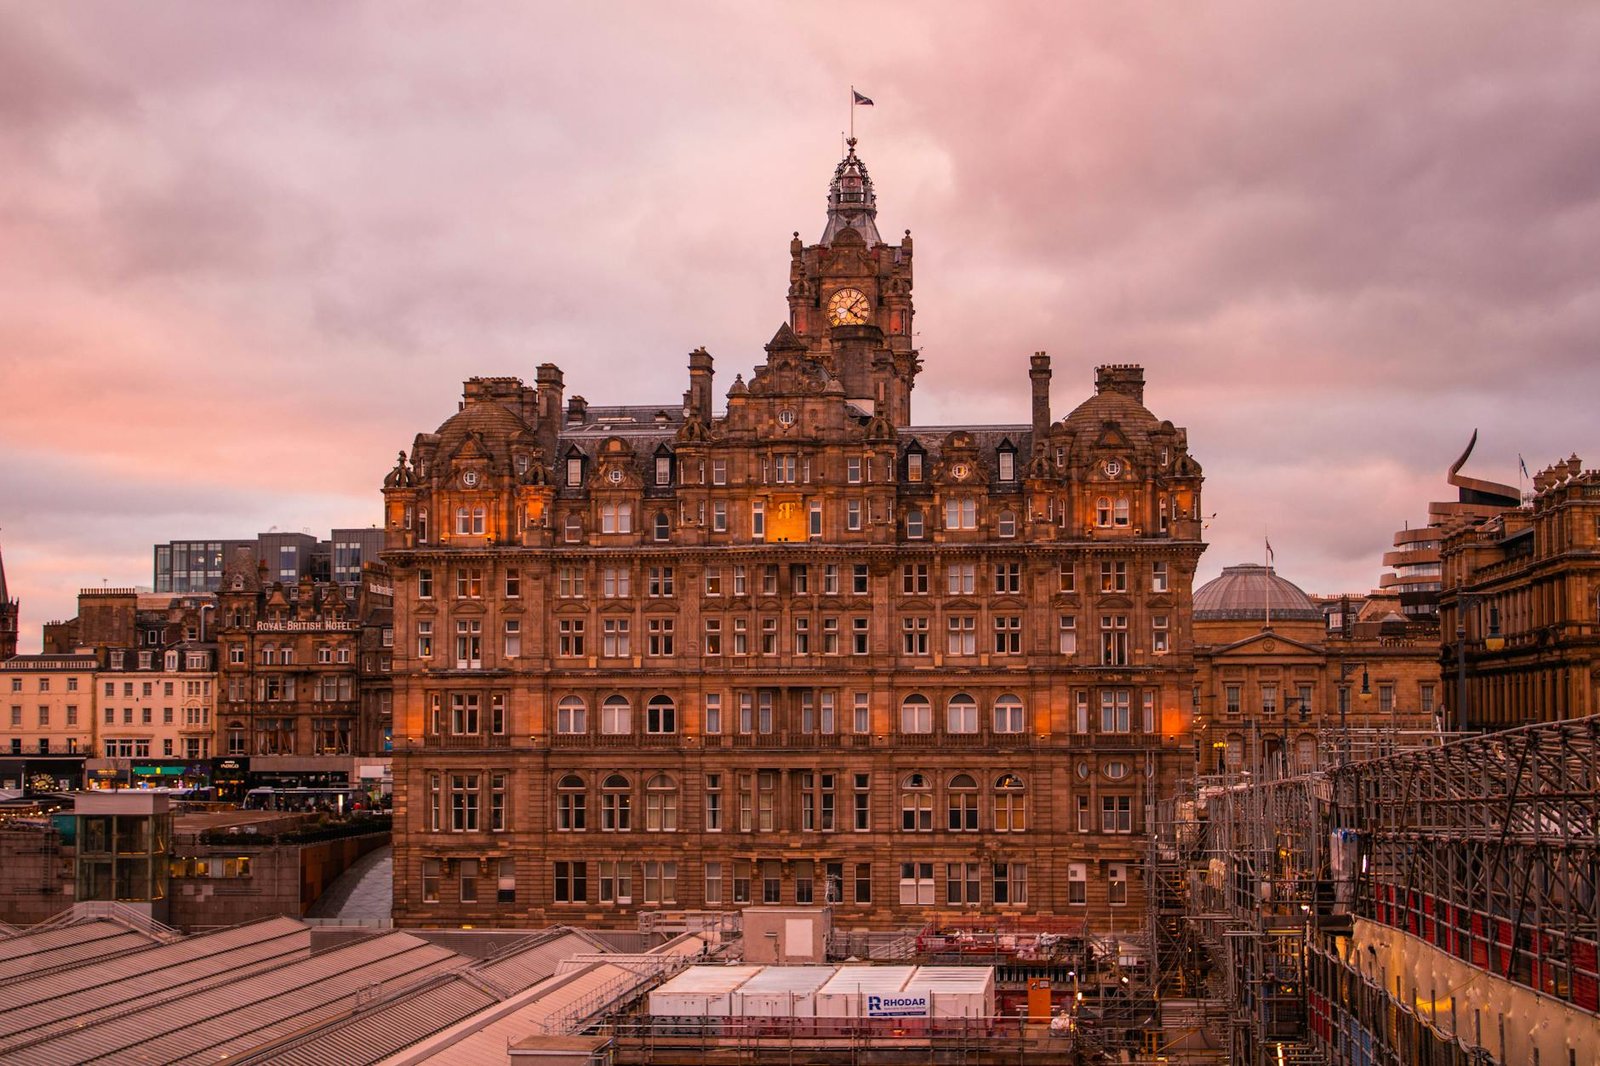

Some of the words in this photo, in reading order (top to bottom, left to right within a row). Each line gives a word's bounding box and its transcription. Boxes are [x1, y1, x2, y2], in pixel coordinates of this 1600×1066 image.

[256, 620, 285, 631] ROYAL
[287, 620, 321, 631] BRITISH
[325, 620, 352, 631] HOTEL
[883, 998, 926, 1007] RHODAR
